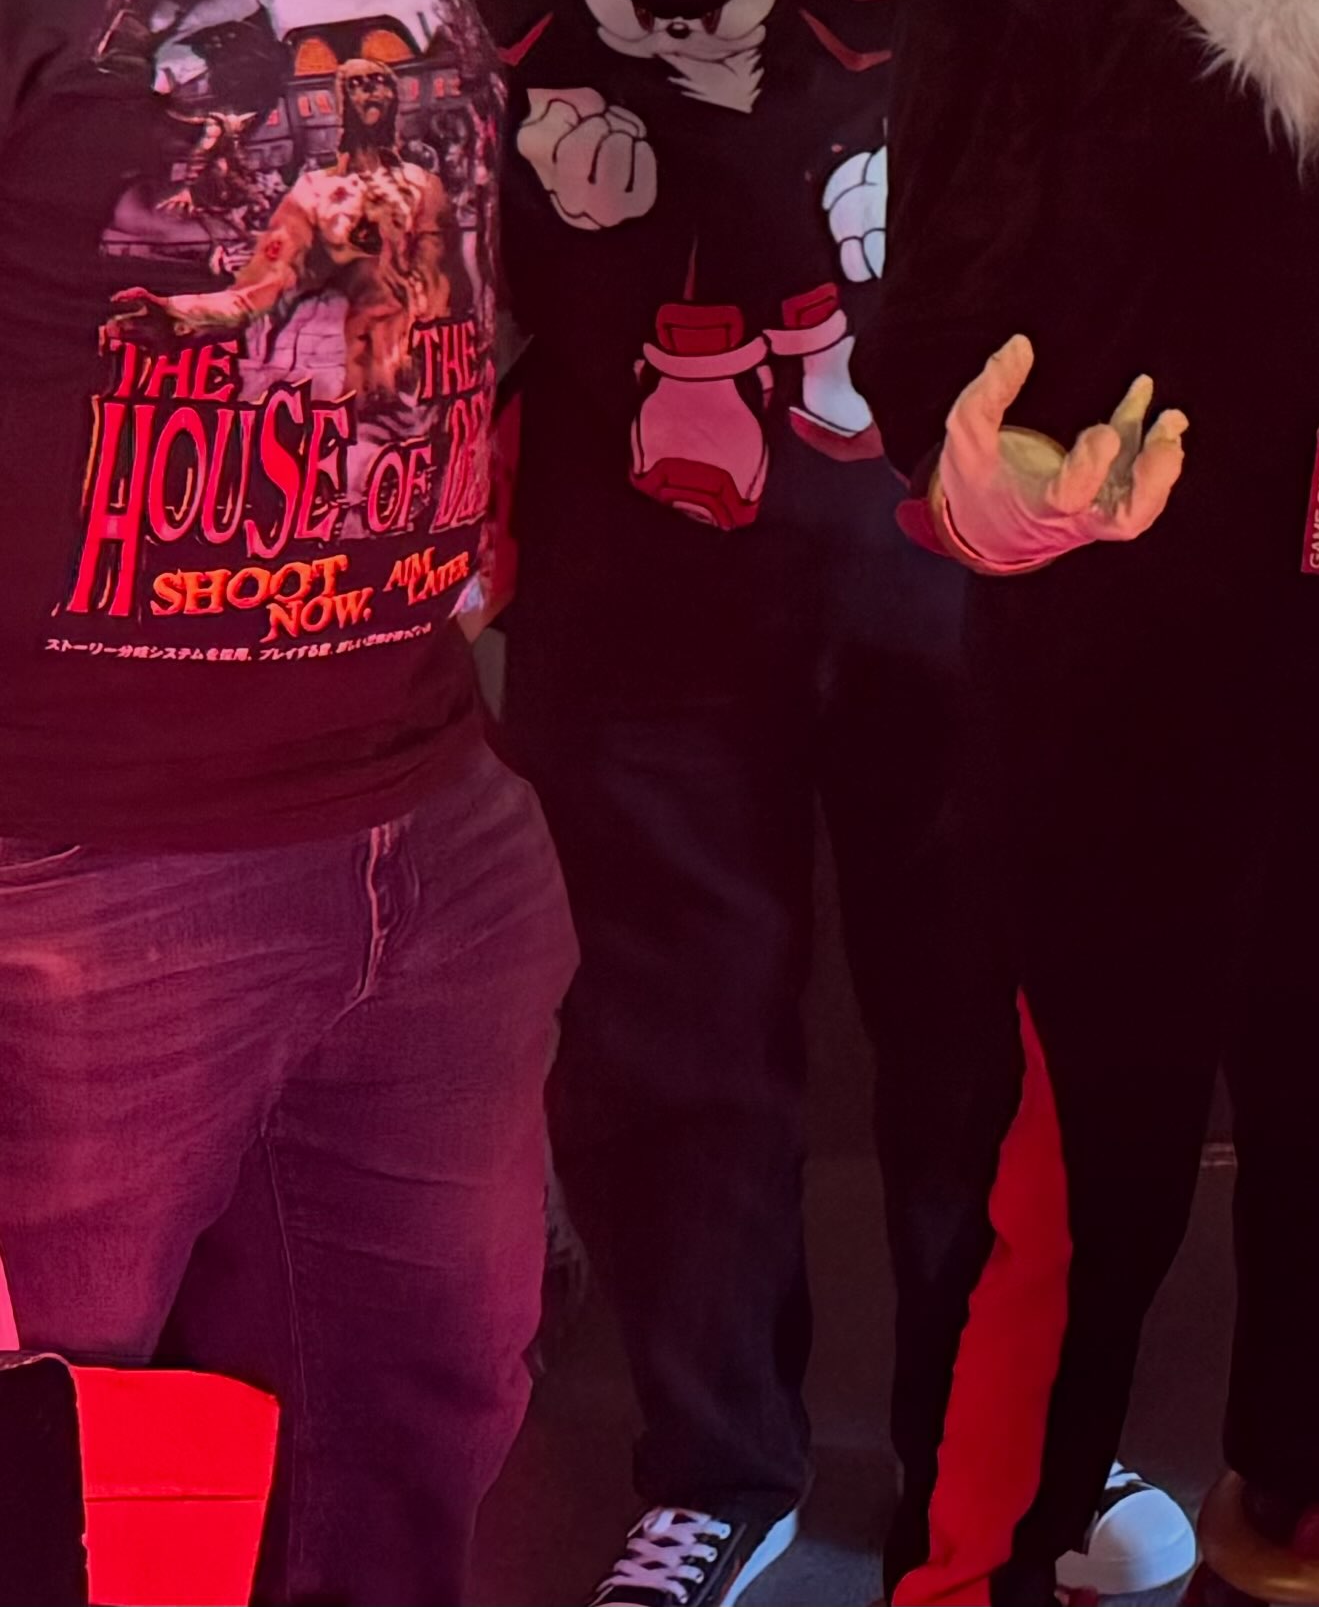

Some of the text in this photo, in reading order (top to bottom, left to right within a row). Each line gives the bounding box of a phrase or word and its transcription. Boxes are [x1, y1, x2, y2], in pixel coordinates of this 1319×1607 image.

[110, 338, 240, 400] THE
[412, 322, 480, 399] THE
[66, 387, 352, 618] HOUSE
[366, 438, 433, 534] OF
[150, 554, 348, 616] SHOOT
